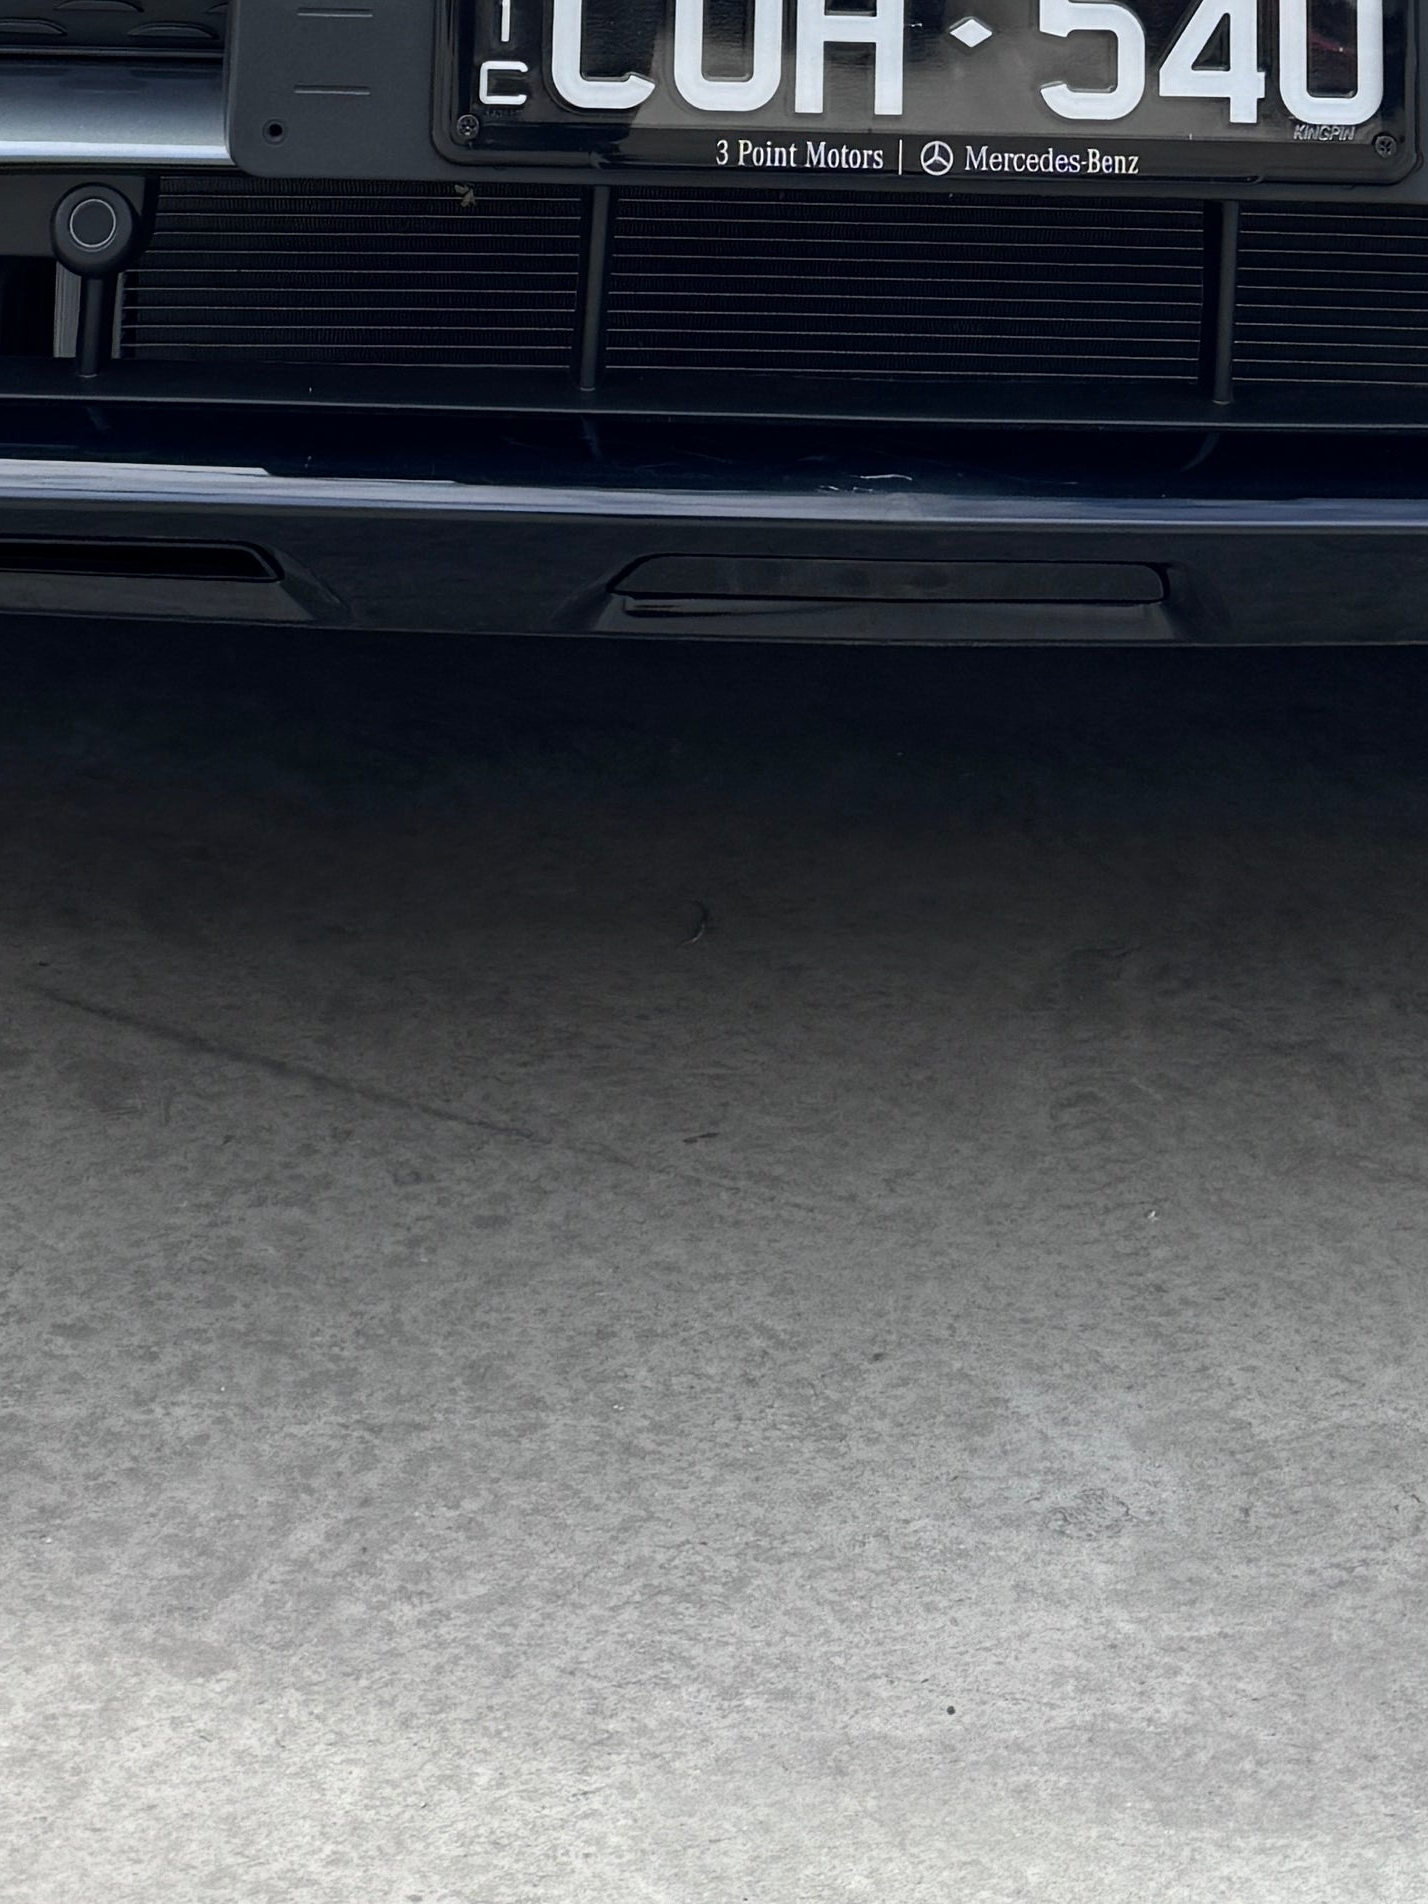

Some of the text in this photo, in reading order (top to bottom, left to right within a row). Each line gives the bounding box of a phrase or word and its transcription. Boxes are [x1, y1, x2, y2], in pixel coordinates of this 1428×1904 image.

[1292, 123, 1357, 142] KINGPIN
[715, 139, 1140, 175] 3 Point Motors Mercedes-Benz
